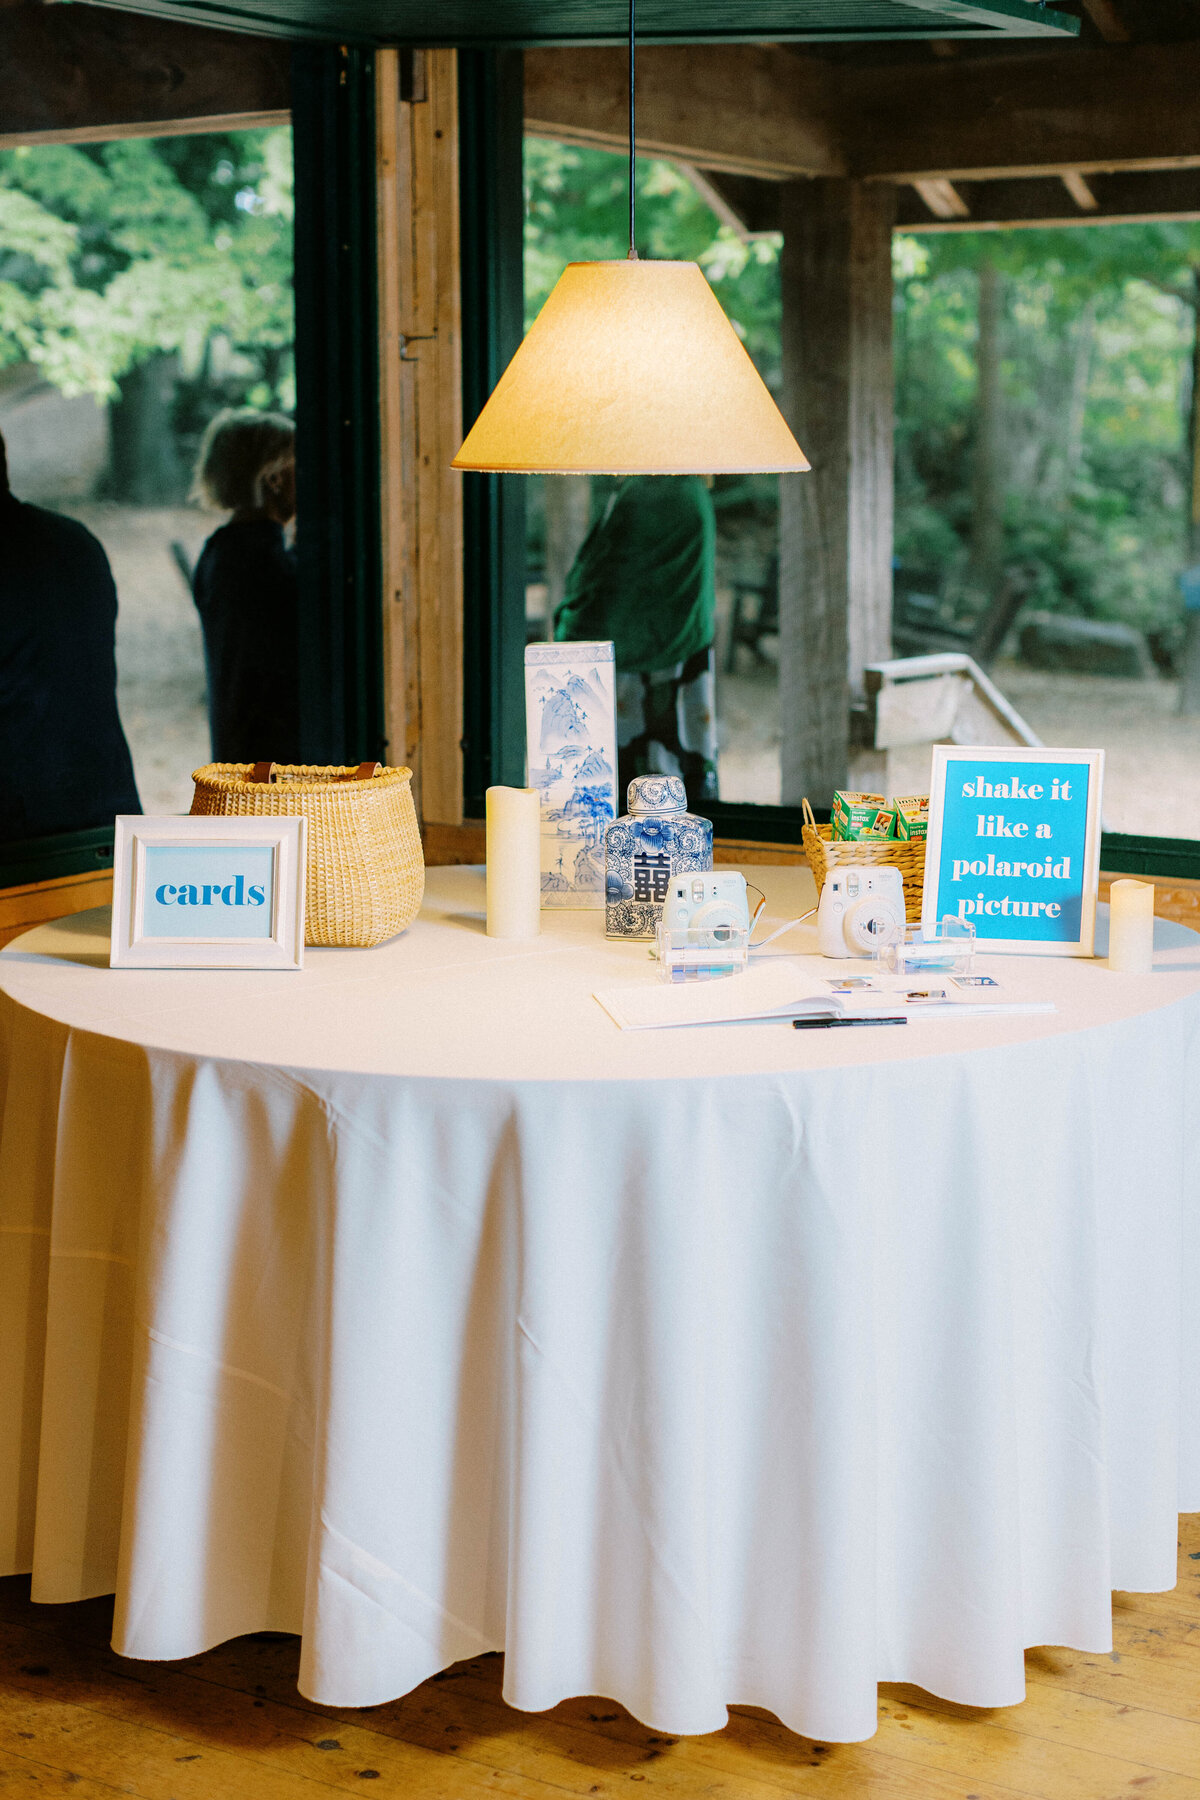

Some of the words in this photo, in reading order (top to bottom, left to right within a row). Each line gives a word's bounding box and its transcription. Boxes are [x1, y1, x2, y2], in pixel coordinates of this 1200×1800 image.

[962, 776, 1044, 800] shake
[1050, 778, 1073, 801] it
[851, 813, 870, 822] instax
[975, 814, 1029, 838] like
[1035, 823, 1053, 839] a
[951, 853, 1071, 882] polaroid
[155, 874, 265, 907] cards
[957, 892, 1062, 919] picture
